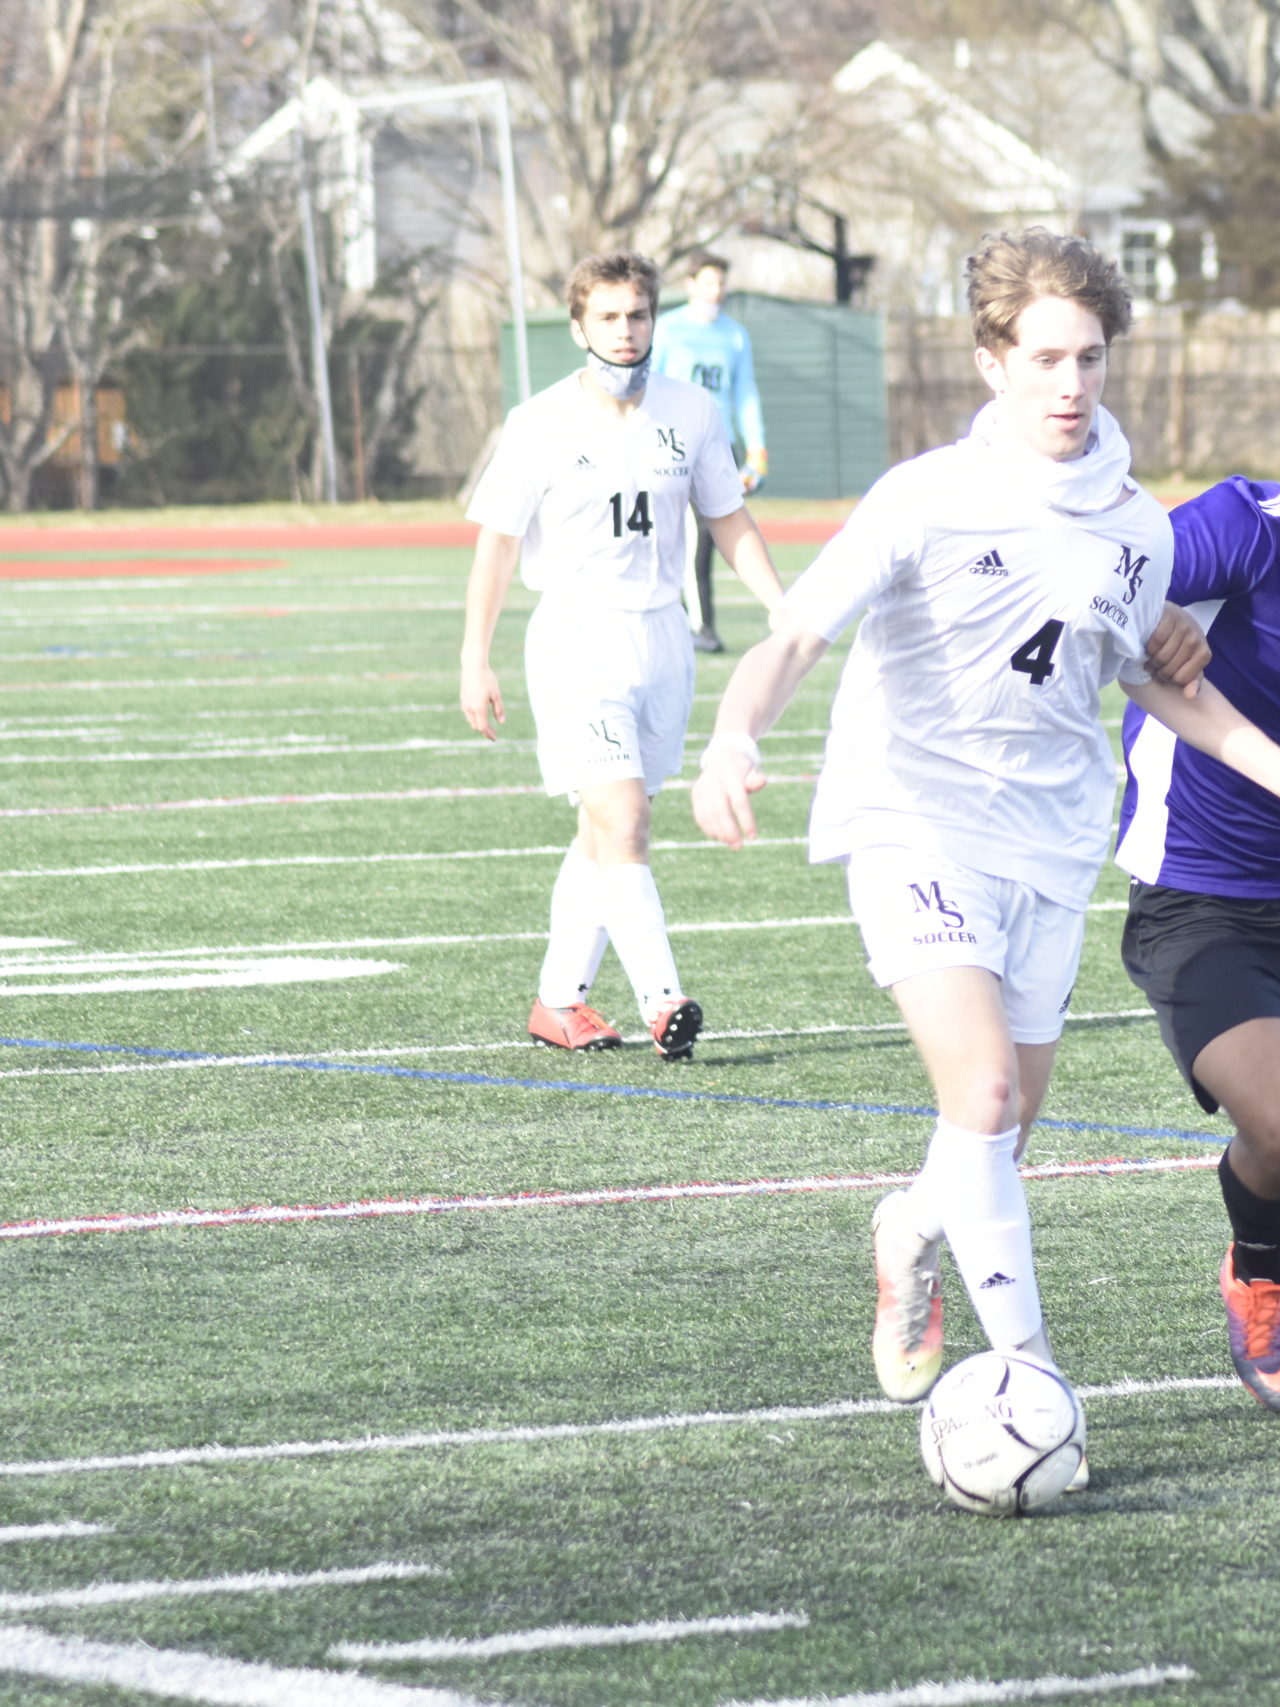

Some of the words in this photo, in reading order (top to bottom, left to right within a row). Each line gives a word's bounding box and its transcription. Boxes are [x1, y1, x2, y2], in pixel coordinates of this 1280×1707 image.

[653, 466, 690, 477] SOCCER
[610, 491, 653, 538] 14
[969, 566, 1009, 577] adidas
[1090, 595, 1129, 630] SOCCER
[1010, 618, 1065, 686] 4
[912, 931, 977, 945] SOCCER
[930, 1396, 1014, 1445] SPALNG
